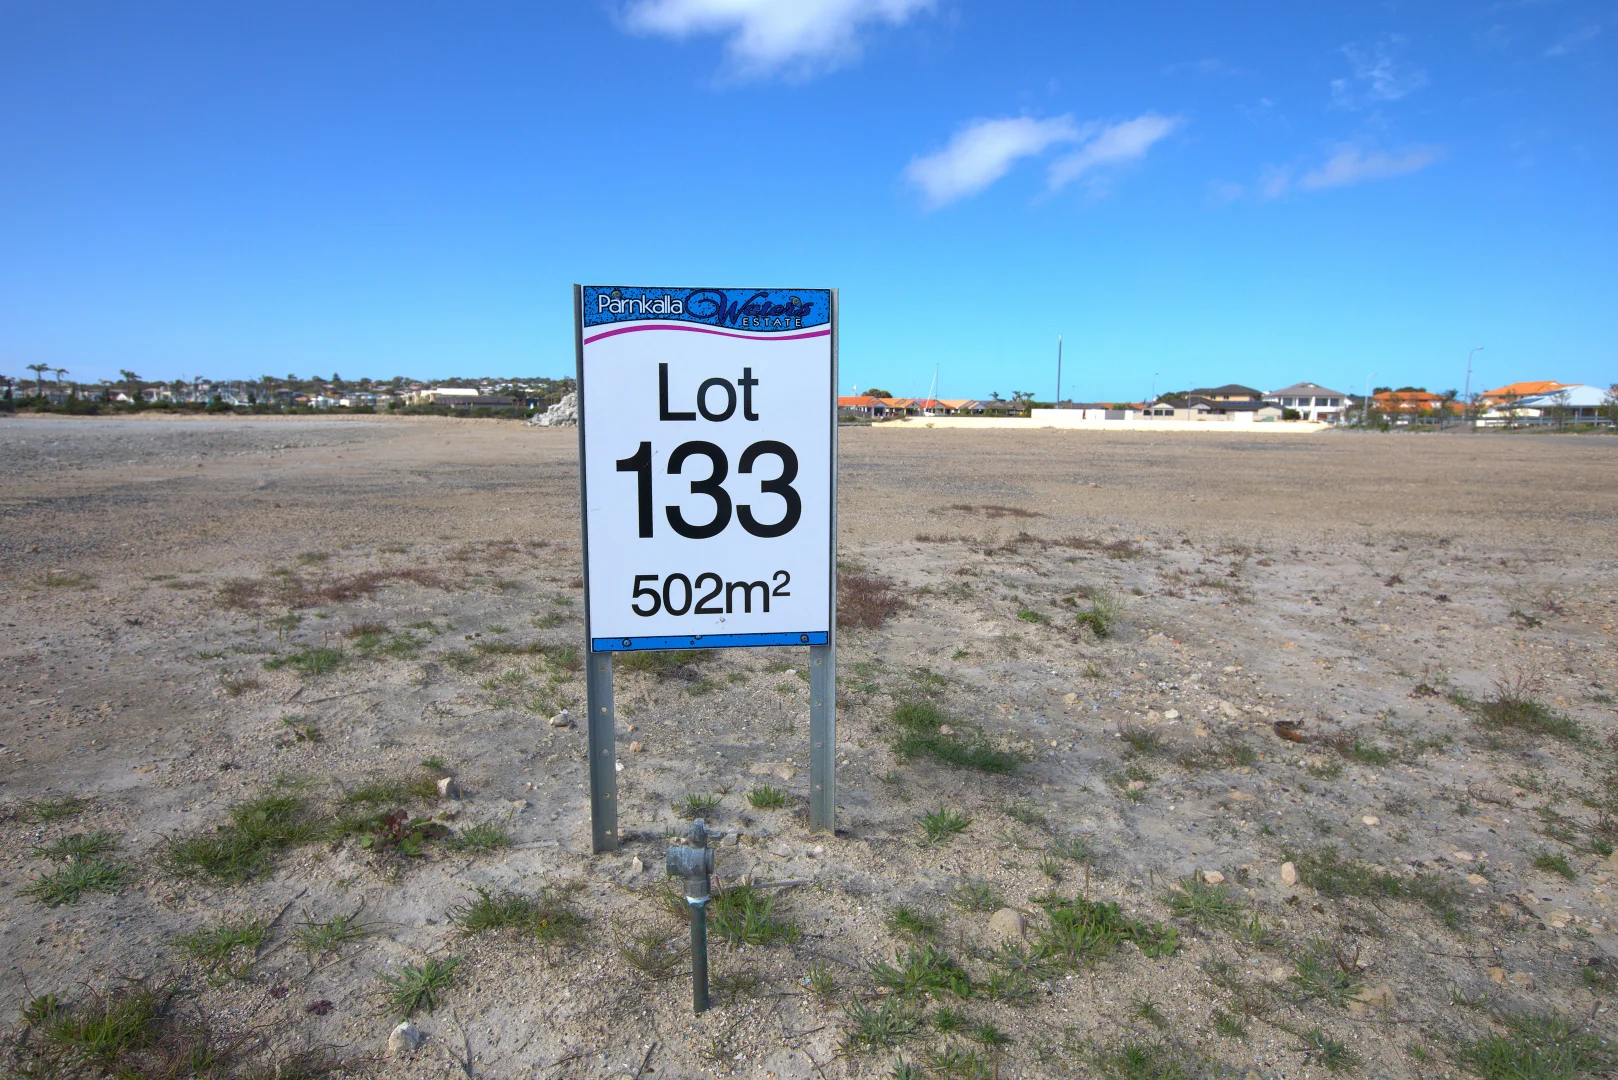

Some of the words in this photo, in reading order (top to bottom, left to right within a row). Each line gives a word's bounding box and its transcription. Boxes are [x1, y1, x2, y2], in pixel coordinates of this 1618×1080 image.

[598, 294, 683, 315] Parnkalla
[685, 289, 815, 325] Waters
[742, 317, 802, 327] ESTATE
[658, 363, 759, 422] Lot
[616, 440, 802, 539] 133
